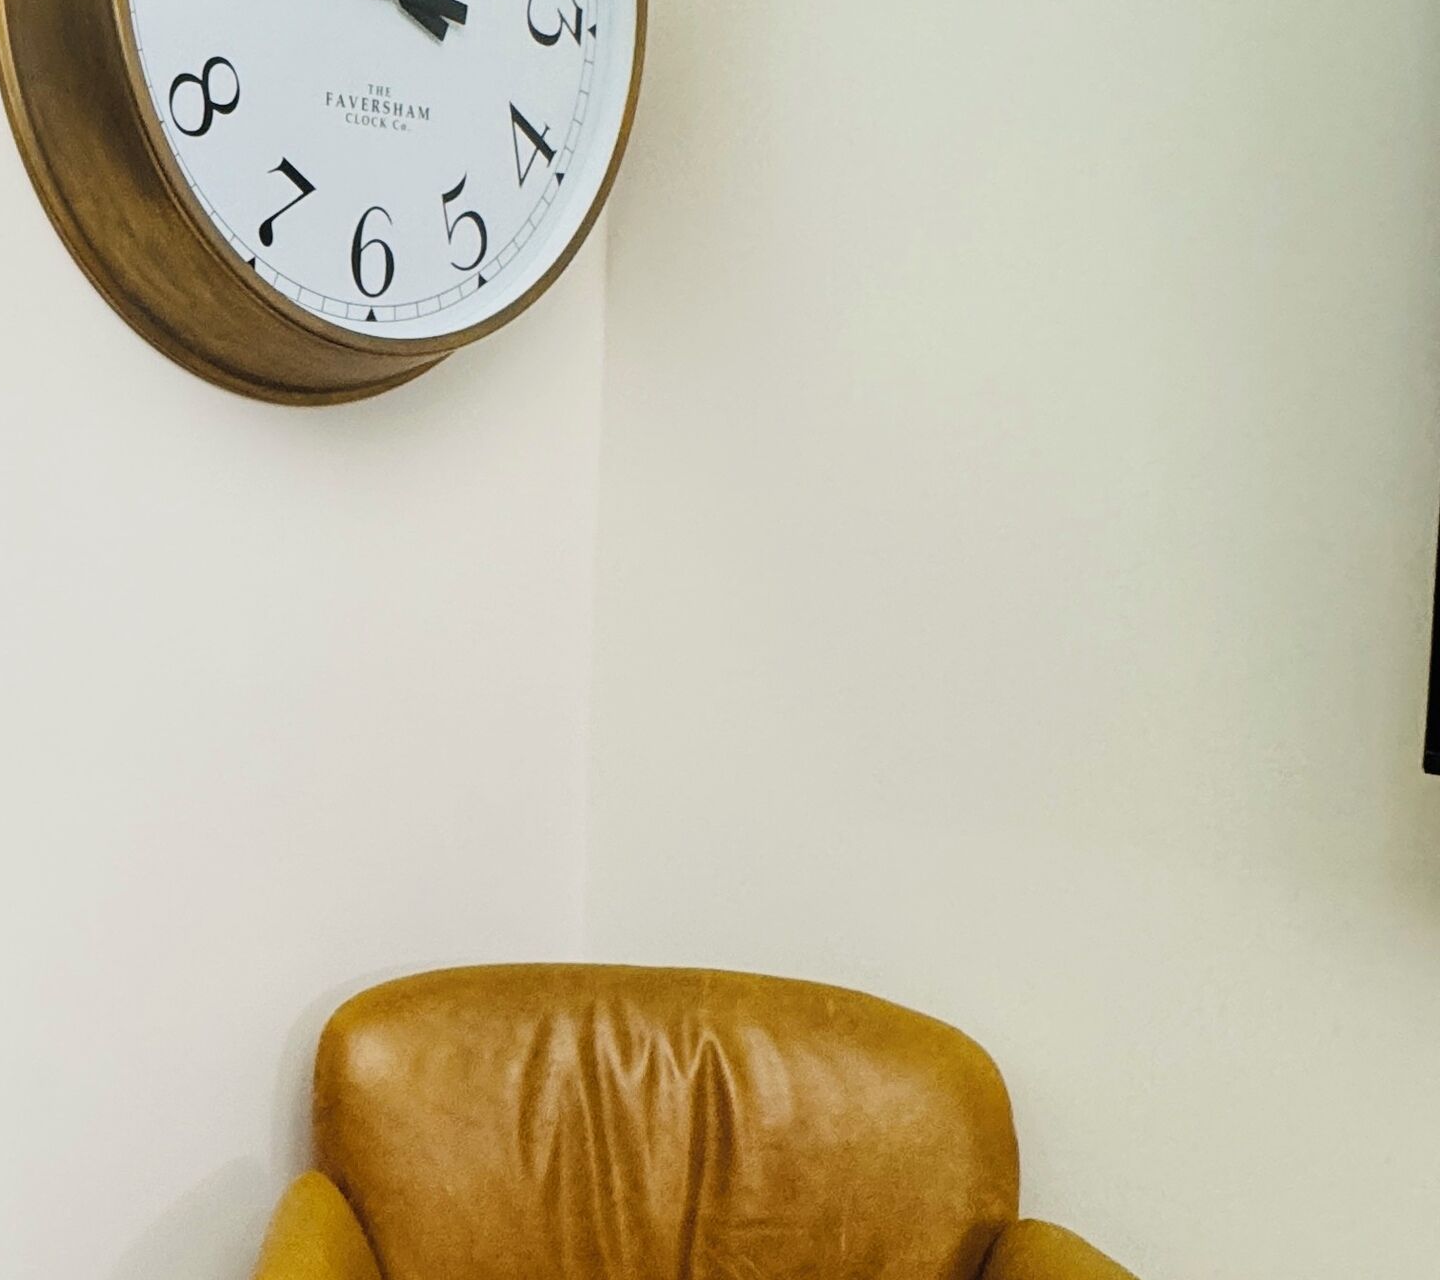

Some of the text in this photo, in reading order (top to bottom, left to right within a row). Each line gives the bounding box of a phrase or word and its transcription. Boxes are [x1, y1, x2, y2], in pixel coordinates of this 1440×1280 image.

[167, 55, 242, 139] 8
[325, 90, 430, 121] FAVERSHAM
[344, 111, 388, 129] CLOCK
[367, 83, 392, 99] THE
[508, 100, 558, 189] 4
[258, 156, 318, 248] 7
[440, 172, 489, 272] 5
[350, 205, 396, 299] 6
